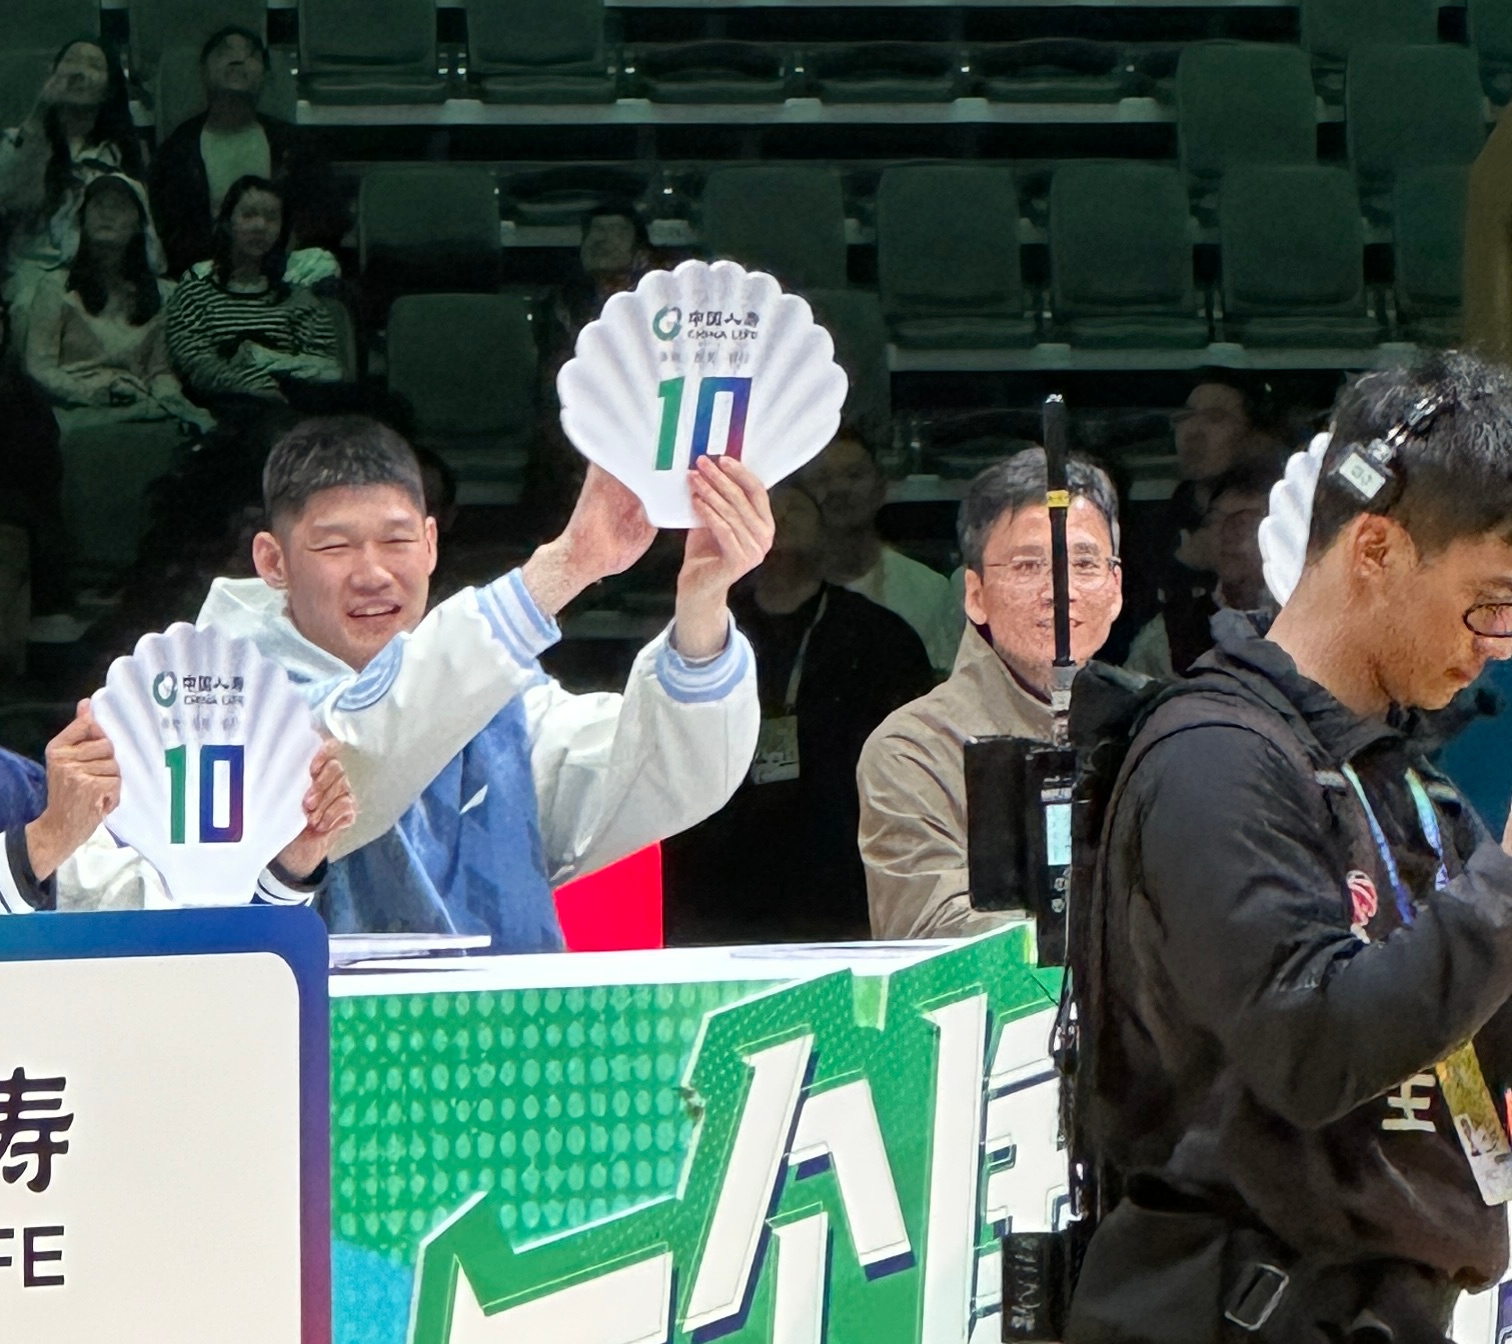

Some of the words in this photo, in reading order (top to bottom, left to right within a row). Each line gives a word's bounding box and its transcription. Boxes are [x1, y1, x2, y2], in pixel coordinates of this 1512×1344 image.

[688, 310, 760, 327] 中国人寿
[654, 375, 753, 471] 10
[165, 744, 245, 845] 10
